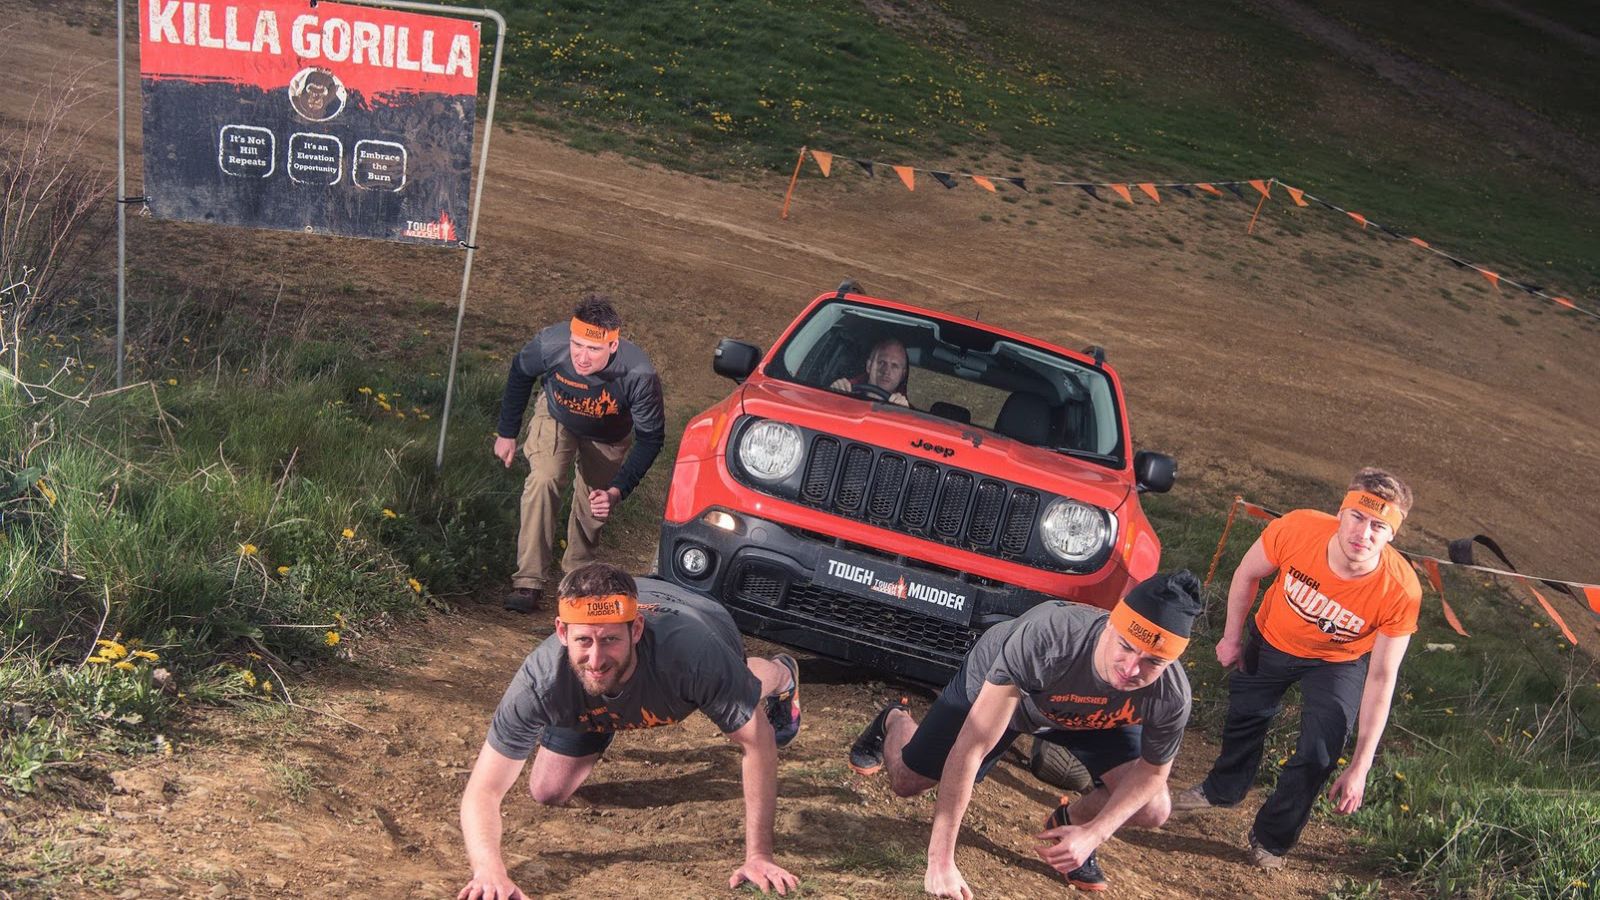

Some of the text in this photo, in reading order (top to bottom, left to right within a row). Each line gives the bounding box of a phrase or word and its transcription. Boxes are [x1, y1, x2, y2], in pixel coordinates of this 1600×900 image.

[149, 0, 474, 78] KILLA GORILLA
[230, 134, 266, 146] It's Not
[304, 142, 317, 150] It's
[240, 146, 258, 155] Hill
[360, 150, 400, 162] Embrace
[228, 155, 266, 167] Repeats
[297, 151, 335, 163] Elevation
[293, 163, 338, 174] Opportunity
[372, 162, 388, 171] the
[367, 172, 391, 182] Burn
[406, 220, 440, 233] TOUGH
[911, 439, 955, 458] Jeep
[828, 559, 875, 586] TOUGH
[1288, 565, 1321, 591] TOUGH
[907, 581, 966, 611] MUDDER
[587, 601, 614, 611] TOUGH
[1283, 572, 1366, 634] MUDDER
[587, 608, 616, 617] MUDDER
[1129, 620, 1154, 640] TOUGH
